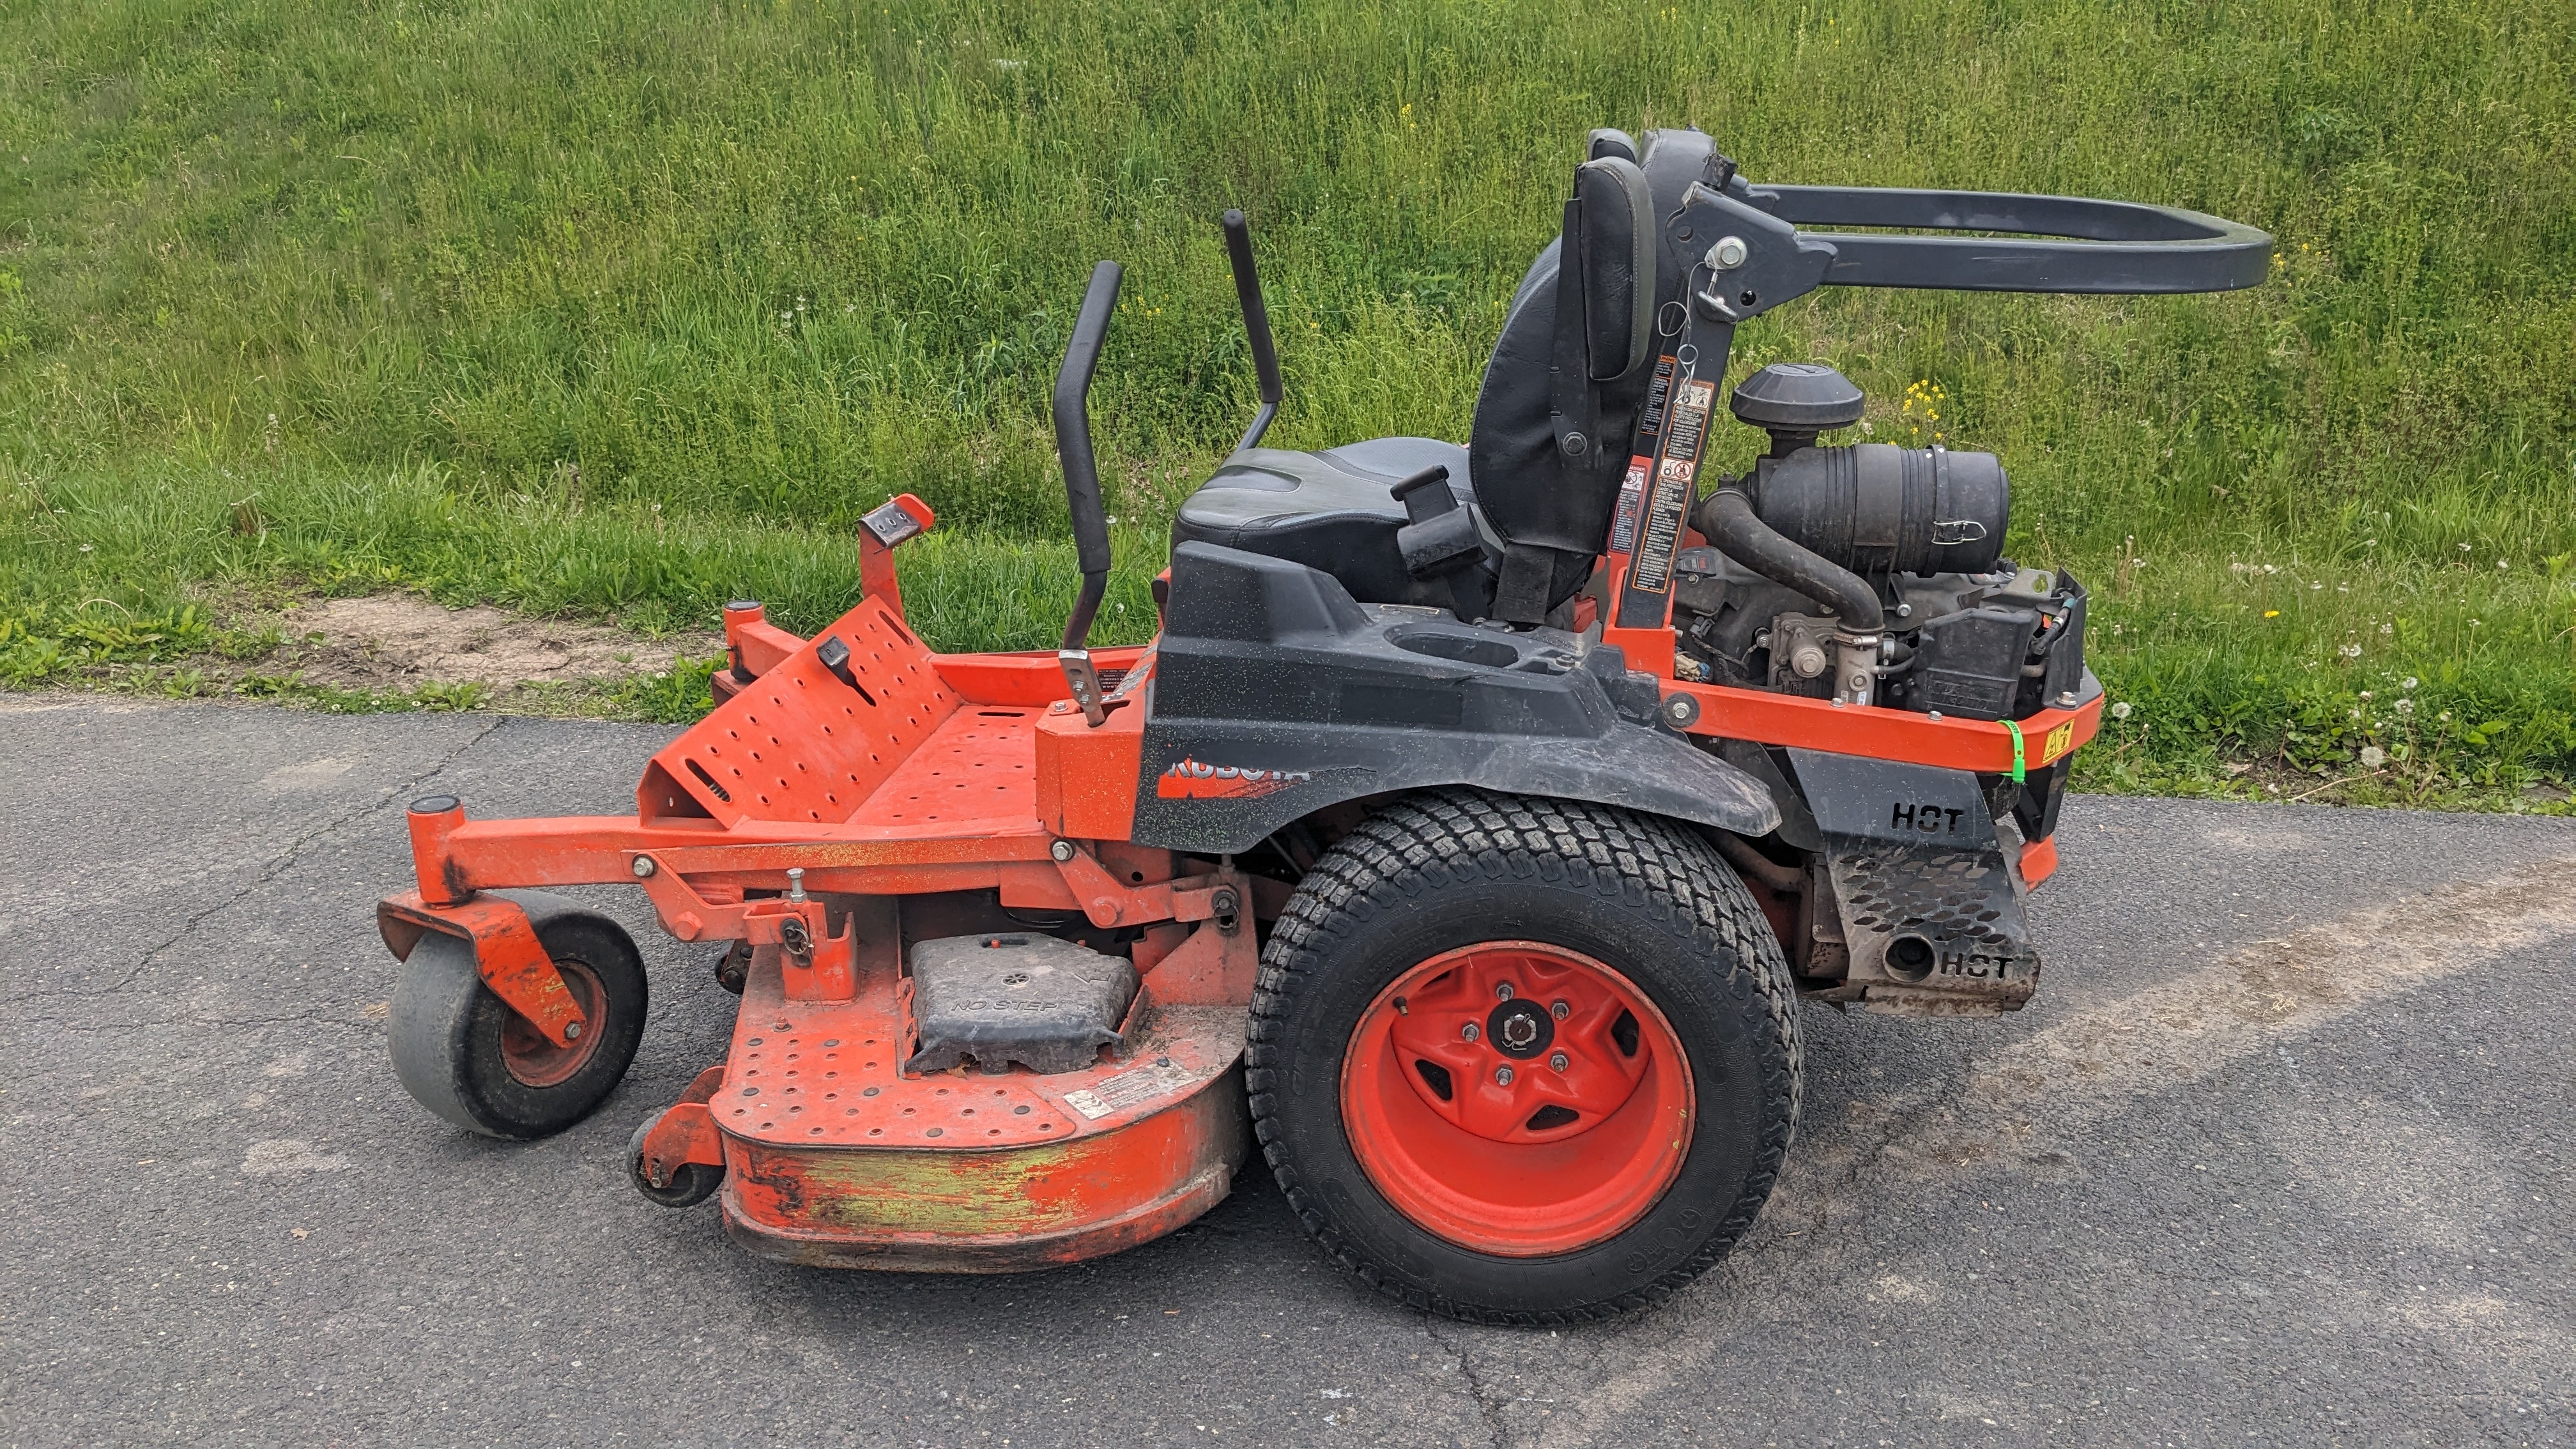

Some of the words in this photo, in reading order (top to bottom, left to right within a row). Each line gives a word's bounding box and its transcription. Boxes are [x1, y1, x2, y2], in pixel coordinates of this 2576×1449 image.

[1892, 802, 1964, 836] HOT
[1940, 951, 2014, 978] HOT
[951, 999, 987, 1011] NO
[993, 1000, 1058, 1012] STEP
[1103, 1069, 1139, 1083] DANGER
